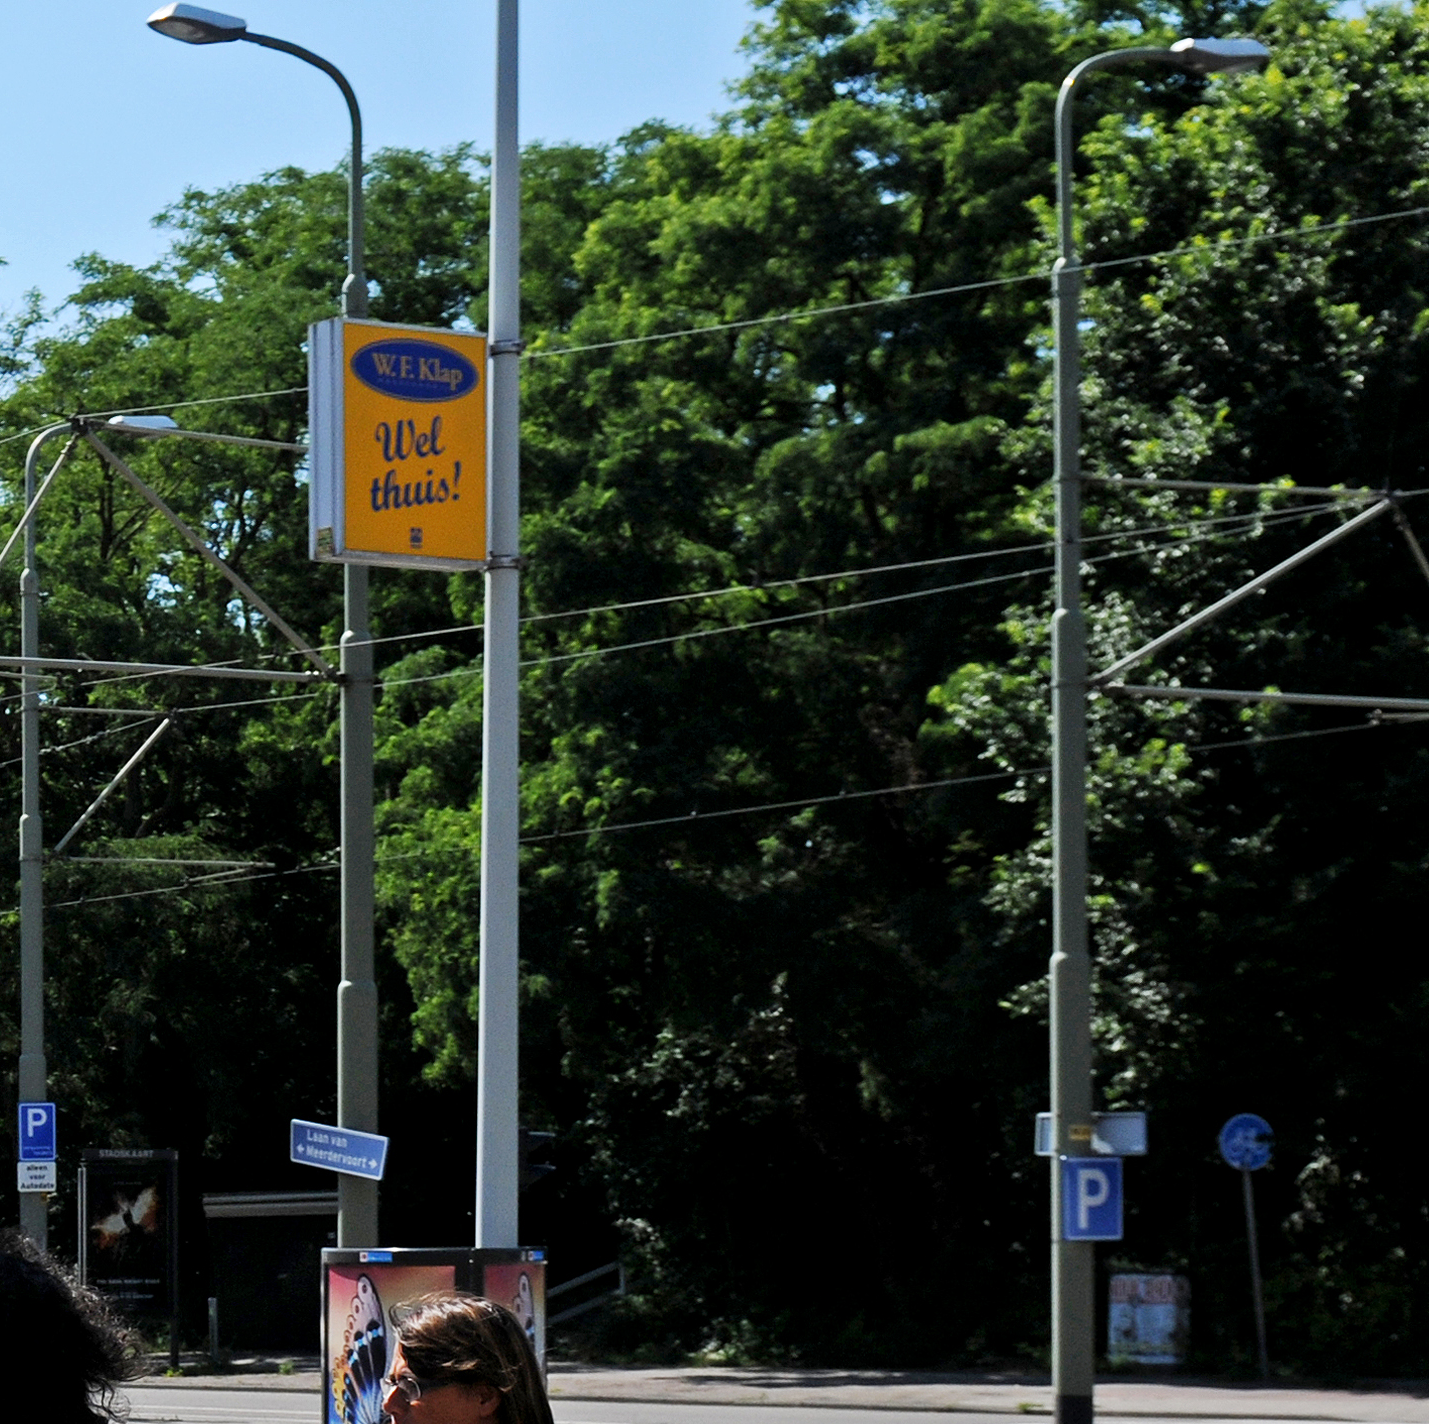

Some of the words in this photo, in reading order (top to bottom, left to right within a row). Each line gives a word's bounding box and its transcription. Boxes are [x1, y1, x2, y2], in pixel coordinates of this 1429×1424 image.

[419, 357, 463, 391] Klap
[375, 415, 446, 462] Wel
[370, 460, 462, 513] thuis!
[27, 1107, 47, 1137] P
[306, 1128, 329, 1144] Laan
[331, 1136, 348, 1148] van
[306, 1145, 367, 1168] Meerdervoort
[1078, 1168, 1109, 1230] P
